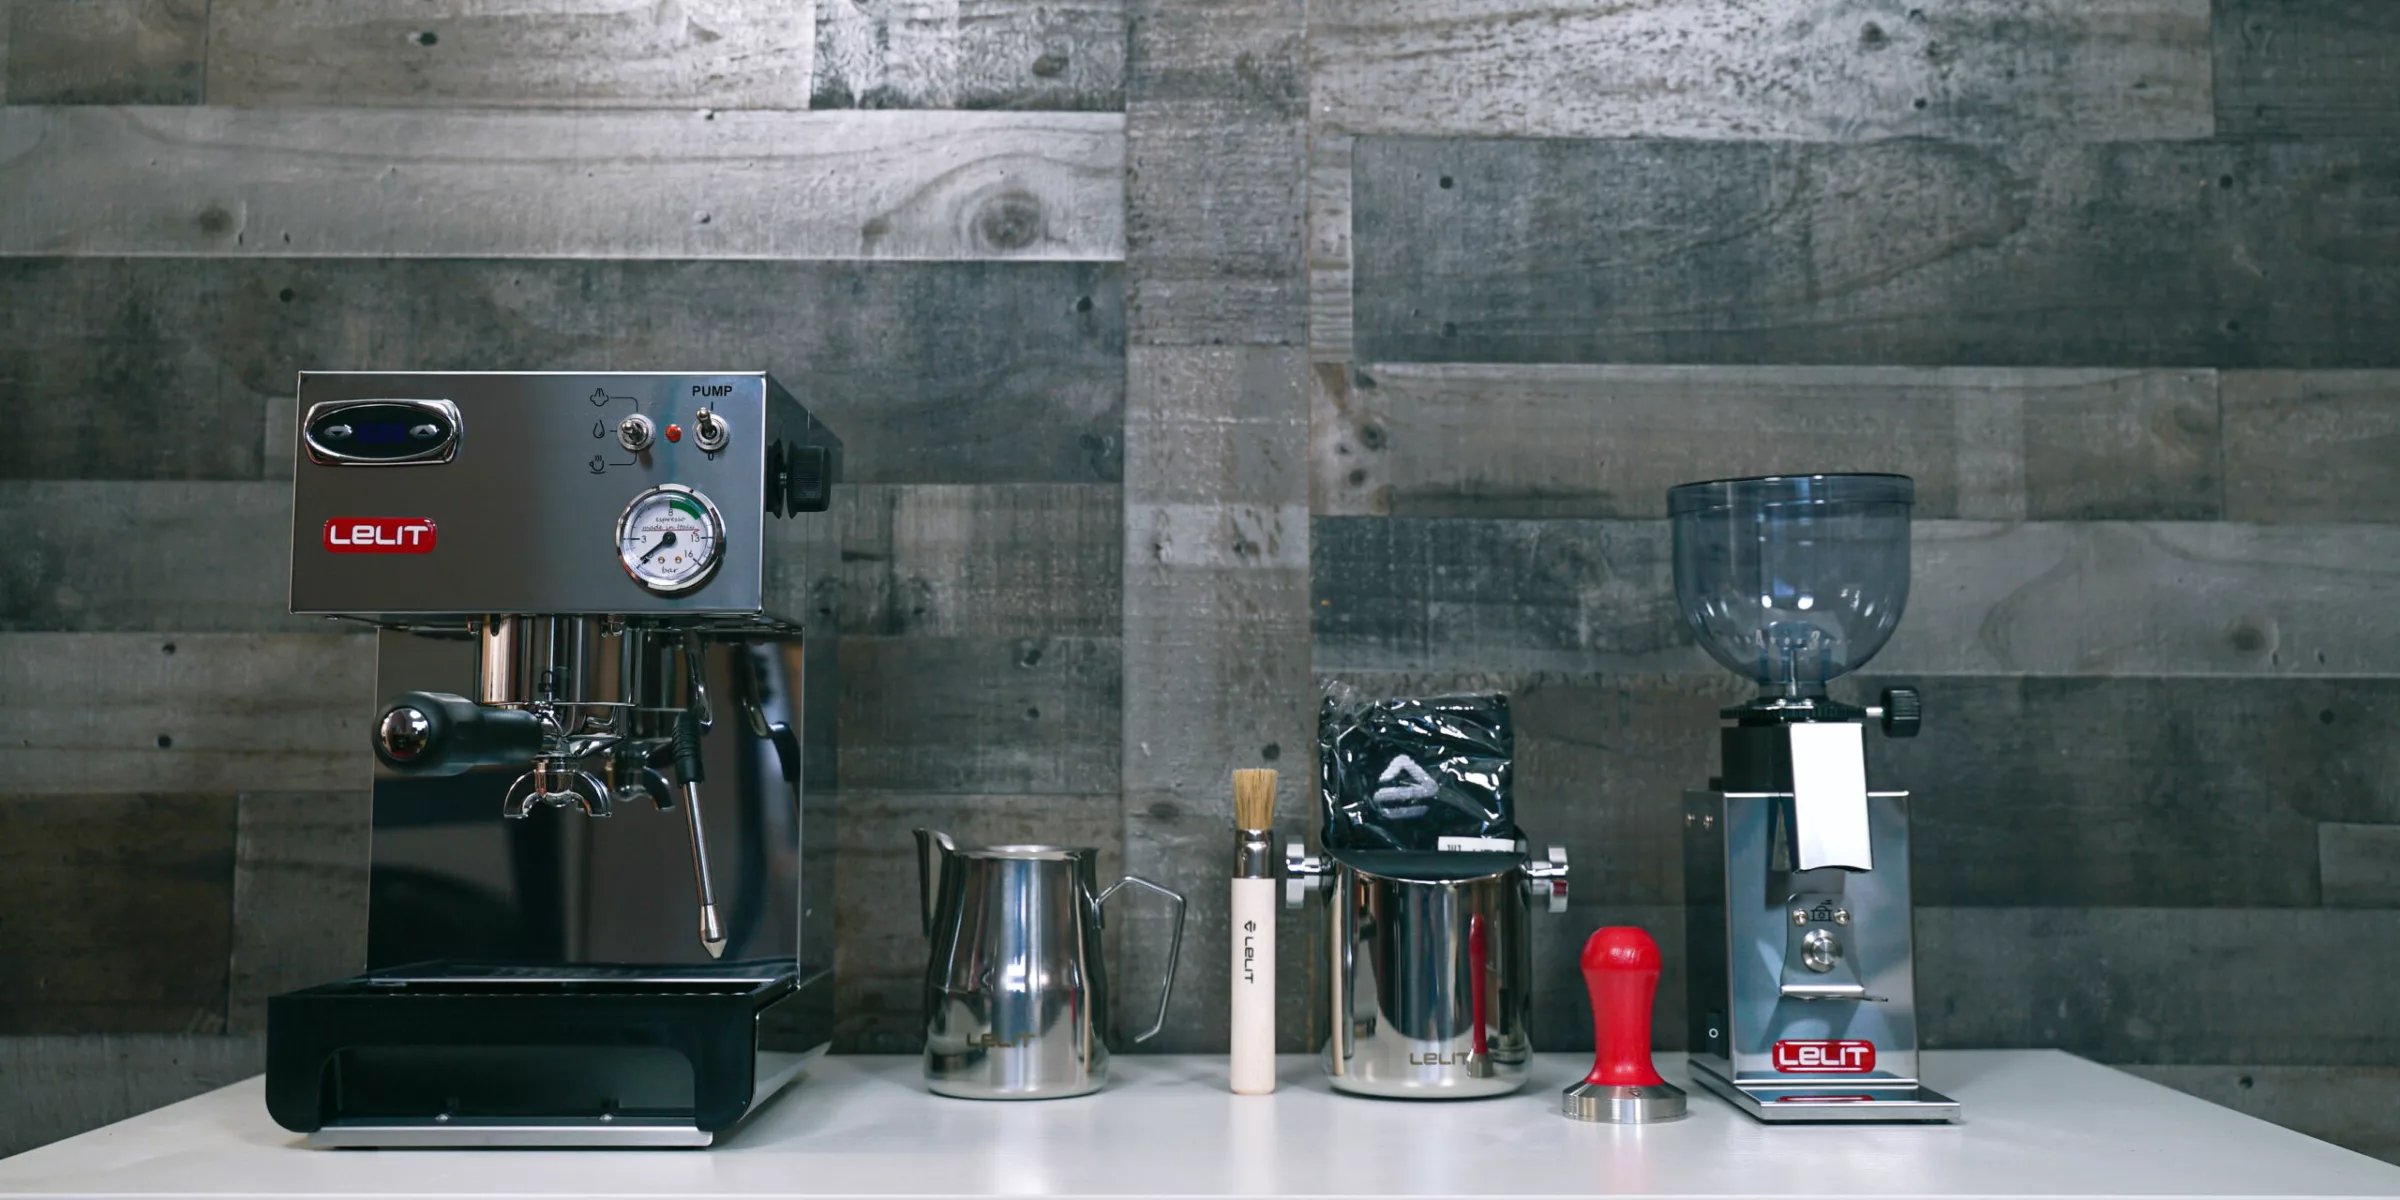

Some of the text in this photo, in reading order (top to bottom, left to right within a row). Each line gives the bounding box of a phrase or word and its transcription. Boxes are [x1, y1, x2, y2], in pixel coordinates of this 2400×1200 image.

[692, 385, 733, 397] PUMP
[640, 535, 647, 543] 3
[691, 534, 700, 543] 13
[684, 550, 693, 558] 16
[661, 566, 679, 574] bar
